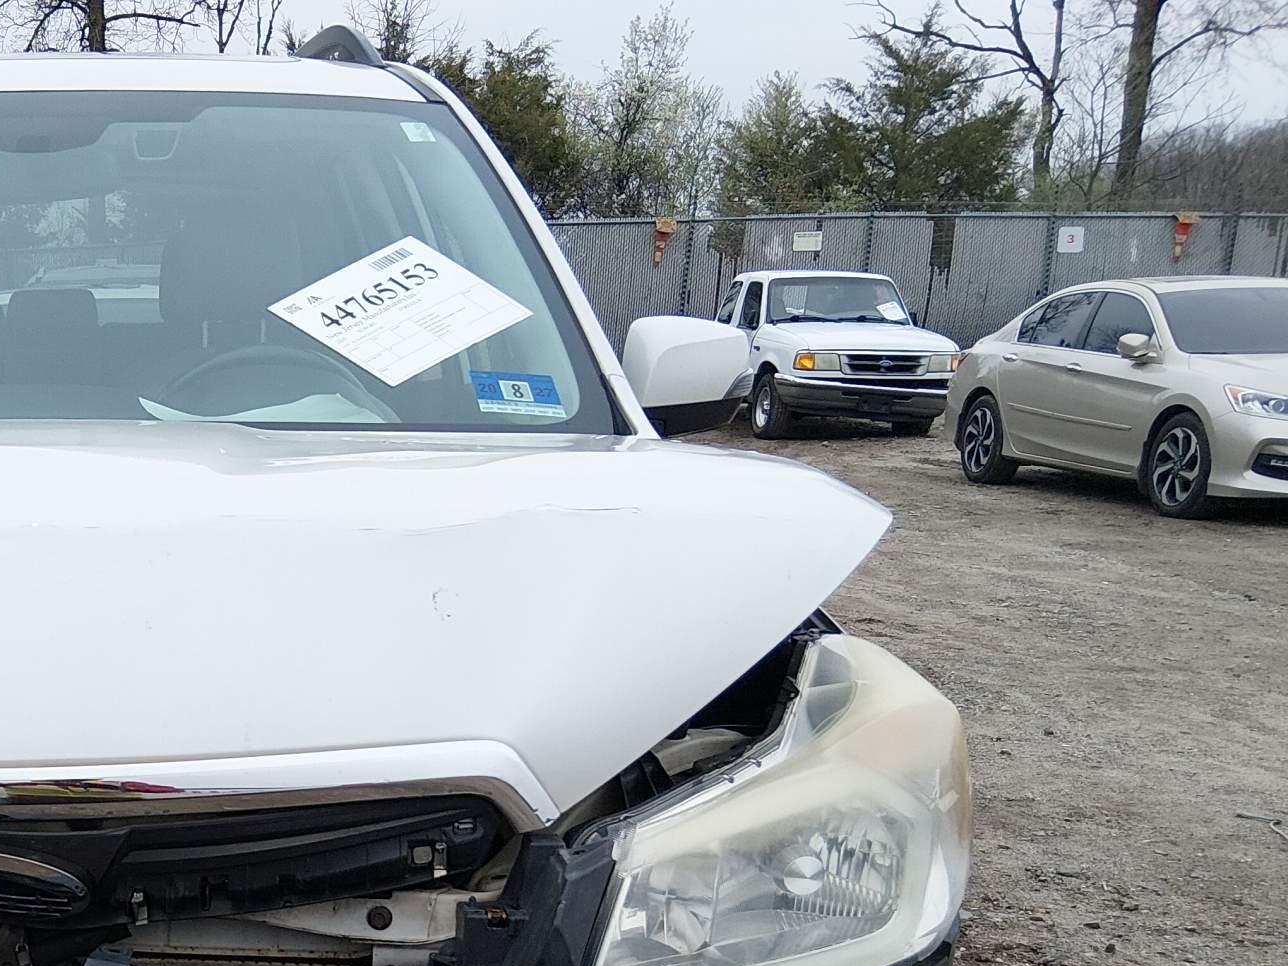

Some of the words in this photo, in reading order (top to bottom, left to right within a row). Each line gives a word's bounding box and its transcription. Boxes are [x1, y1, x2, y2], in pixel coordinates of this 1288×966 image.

[1066, 234, 1074, 244] 3
[320, 263, 439, 328] 44765153
[511, 383, 524, 398] 8
